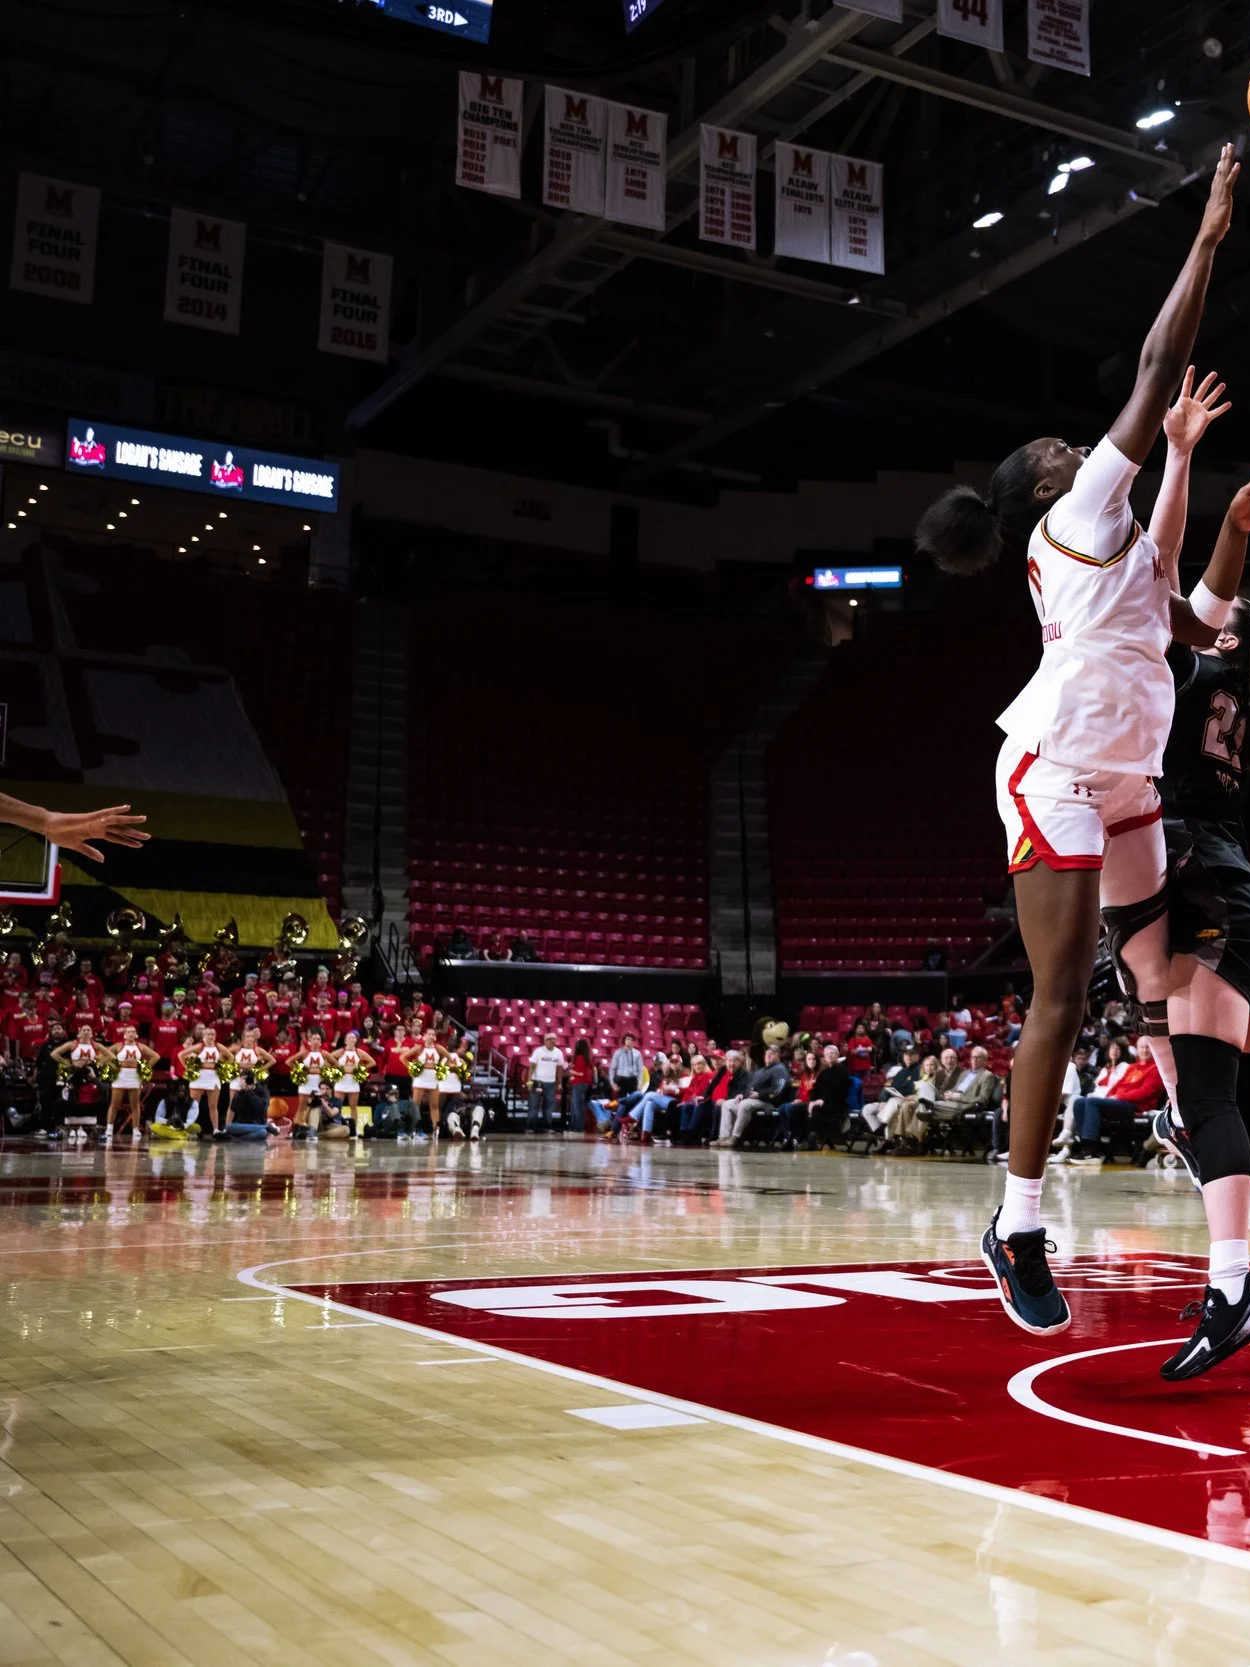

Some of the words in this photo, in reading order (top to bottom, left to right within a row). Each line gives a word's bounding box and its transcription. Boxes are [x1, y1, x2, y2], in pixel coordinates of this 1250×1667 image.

[428, 6, 453, 24] 3RD
[629, 0, 646, 22] 2:19
[952, 0, 989, 26] 44
[480, 76, 504, 104] M
[462, 110, 519, 133] CHAMPIONS
[469, 101, 489, 116] BIG
[492, 106, 512, 120] TEN
[564, 94, 588, 125] M
[625, 111, 649, 141] M
[718, 132, 740, 162] M
[793, 150, 814, 178] M
[847, 162, 867, 190] M
[44, 183, 75, 219] M
[27, 221, 84, 246] FINAL
[193, 219, 223, 252] M
[28, 238, 81, 262] FOUR
[178, 254, 233, 279] FINAL
[345, 252, 371, 285] M
[180, 271, 228, 294] FOUR
[177, 294, 227, 322] 2014
[331, 287, 382, 310] FINAL
[333, 304, 378, 325] FOUR
[115, 440, 159, 470] LOGAN'S
[158, 447, 203, 477] SAUSAGE
[252, 463, 293, 492] LOGAN'S
[292, 470, 335, 498] SAUSAGE
[79, 1049, 91, 1059] M
[125, 1049, 137, 1060] M
[205, 1051, 217, 1061] M
[240, 1053, 252, 1062] M
[309, 1056, 321, 1065] M
[345, 1054, 356, 1064] M
[424, 1052, 436, 1061] M
